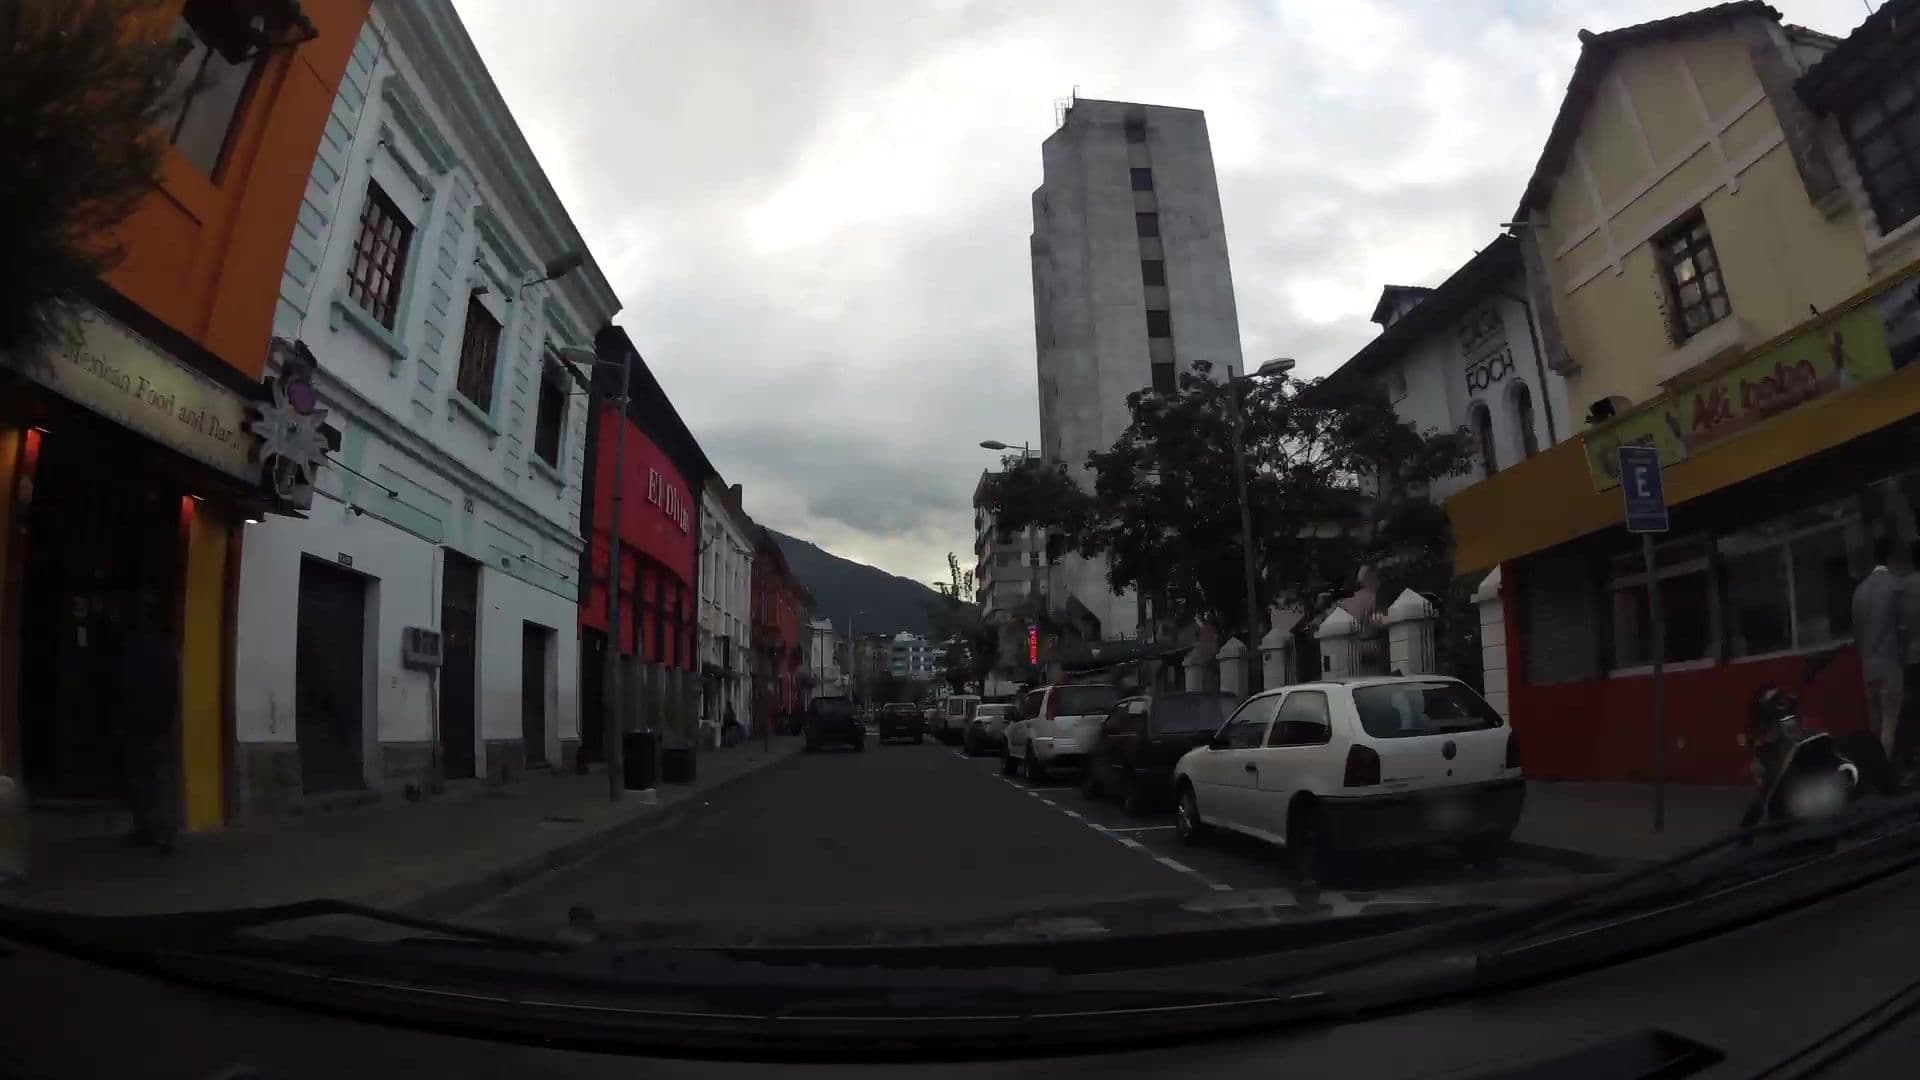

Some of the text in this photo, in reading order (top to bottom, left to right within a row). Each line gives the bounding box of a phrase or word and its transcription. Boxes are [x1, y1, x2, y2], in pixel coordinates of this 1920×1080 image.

[1464, 347, 1515, 397] FOCH
[134, 376, 175, 417] Food
[178, 406, 205, 433] and
[1635, 465, 1651, 496] E
